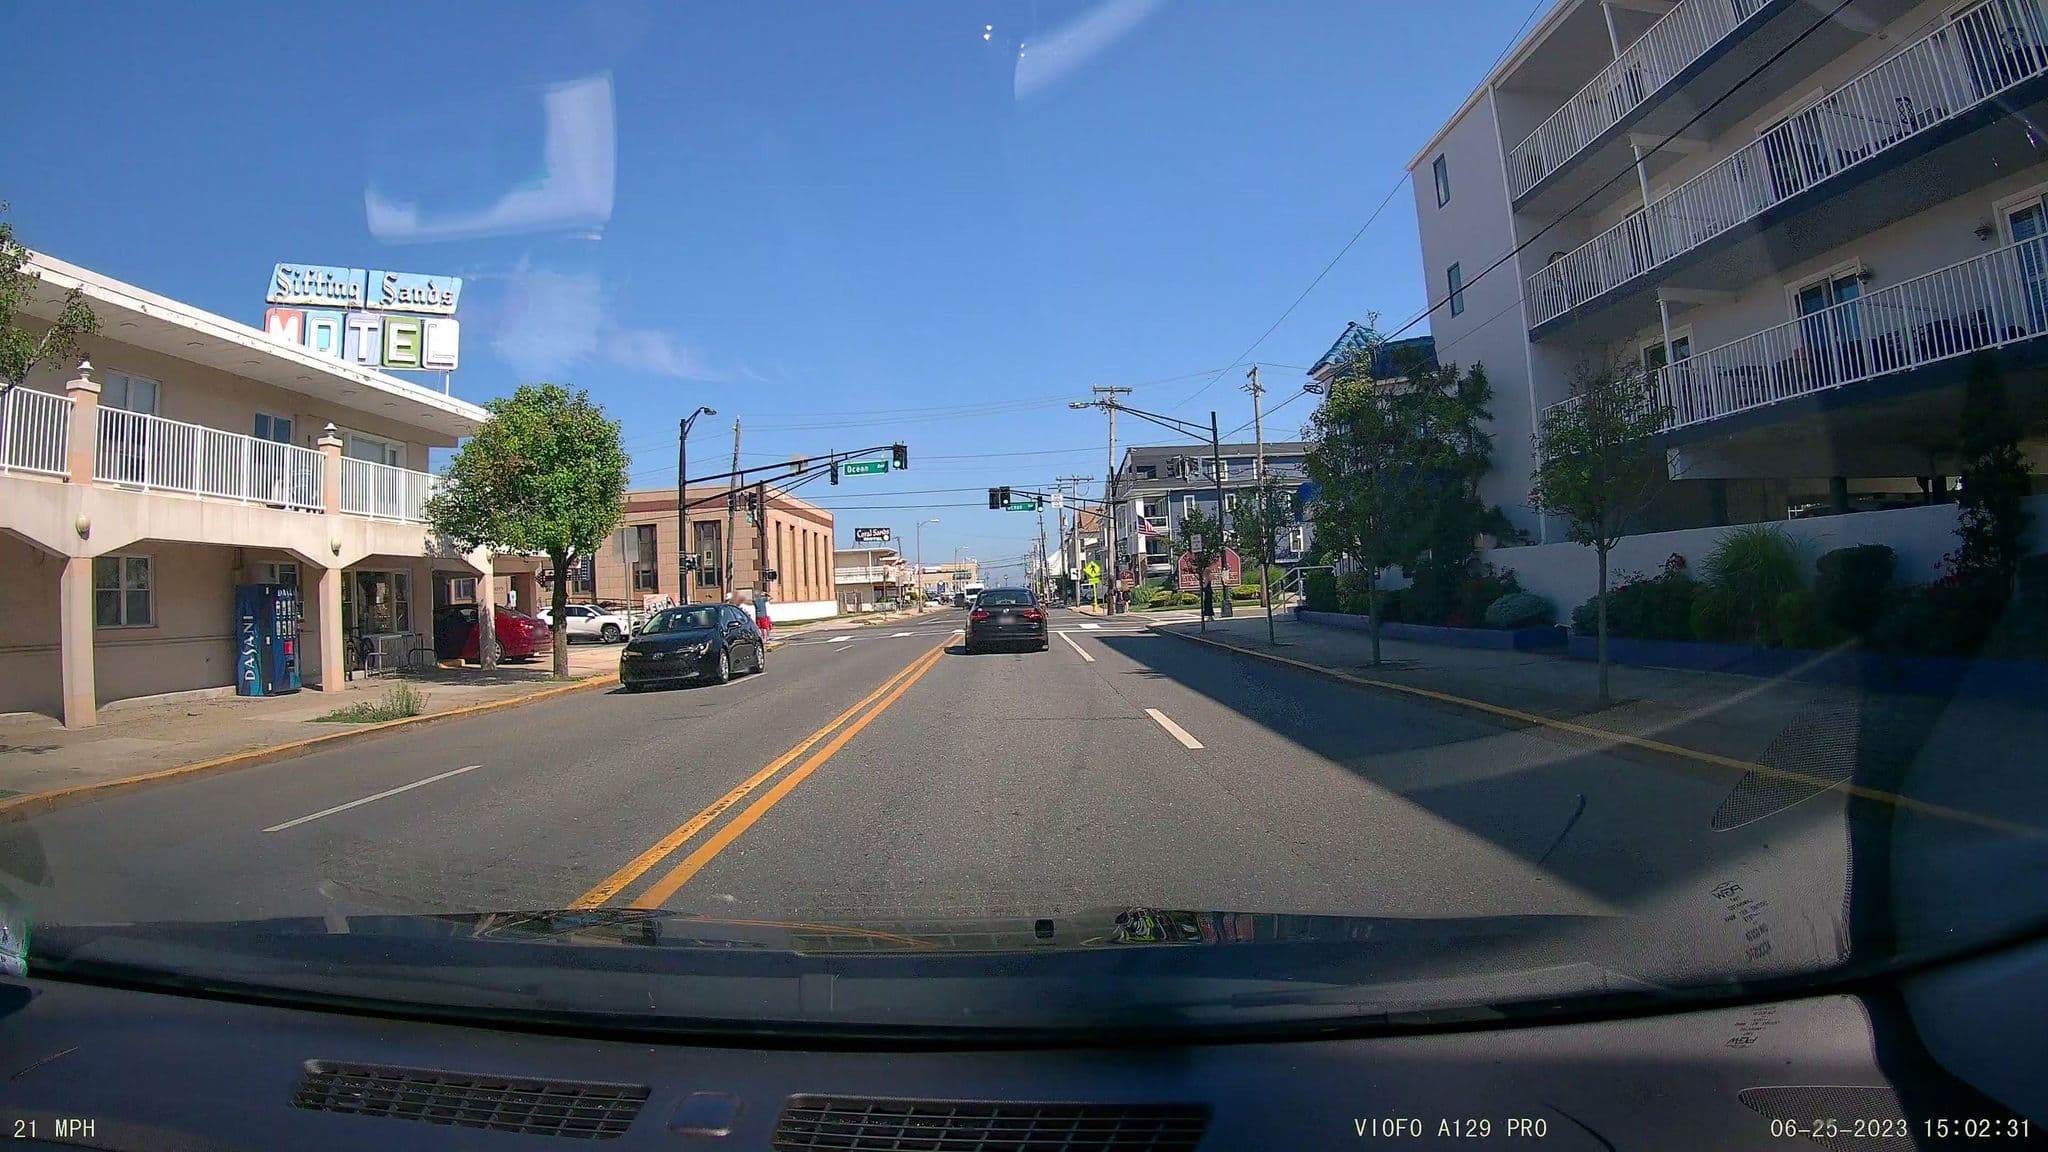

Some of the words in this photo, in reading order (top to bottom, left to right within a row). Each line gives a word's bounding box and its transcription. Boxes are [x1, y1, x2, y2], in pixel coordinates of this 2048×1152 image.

[274, 265, 362, 303] Sifting
[379, 273, 456, 307] Sands
[267, 314, 456, 365] MOTEL
[846, 465, 869, 474] Ocean
[856, 529, 873, 539] Coral
[873, 528, 890, 537] Sands
[242, 615, 257, 681] DASANI
